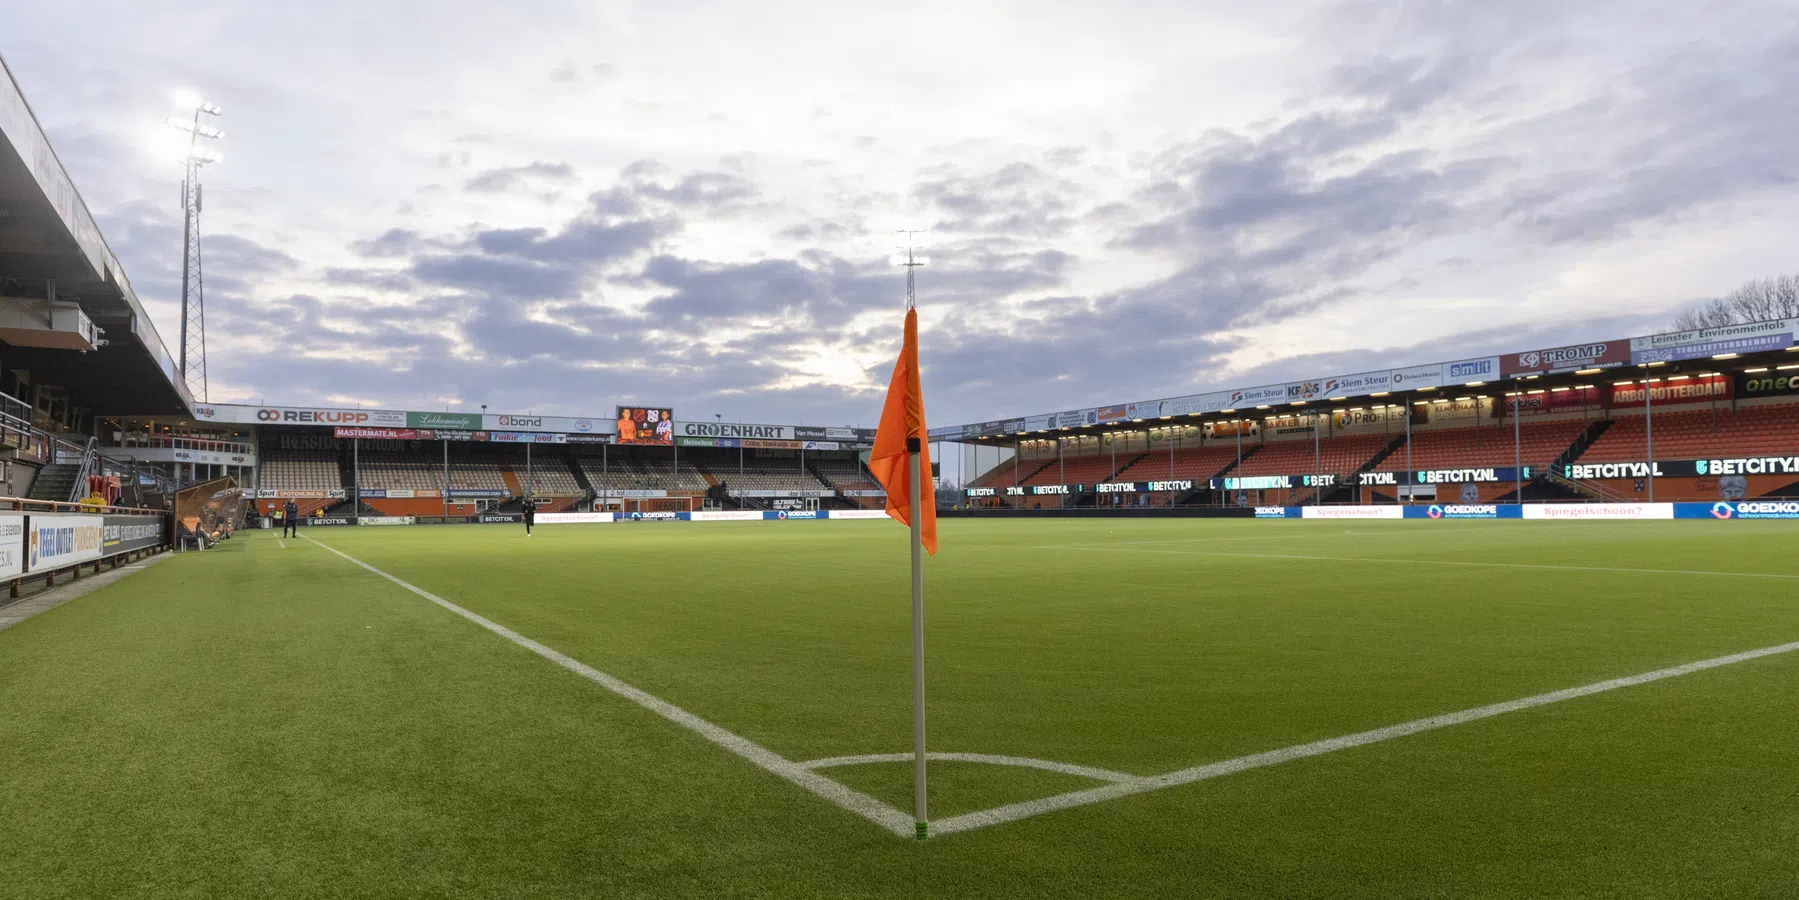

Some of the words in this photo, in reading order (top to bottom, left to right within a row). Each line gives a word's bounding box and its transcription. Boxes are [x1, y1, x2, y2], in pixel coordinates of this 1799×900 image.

[1652, 333, 1693, 344] Leinster
[1699, 320, 1786, 338] Environmentals
[1542, 344, 1606, 363] TROMP
[1452, 361, 1491, 376] smit
[1341, 380, 1363, 388] Siem
[1365, 376, 1388, 385] Steur
[1244, 391, 1263, 399] Siem
[1264, 389, 1283, 397] Steur
[1613, 388, 1645, 404] ARBO
[1649, 382, 1726, 400] ROTTERDAM
[1173, 405, 1190, 414] HOTEL
[1192, 401, 1226, 413] VOLENDAM
[284, 411, 369, 423] REKUPP
[1264, 418, 1299, 429] BAKKER
[336, 428, 398, 438] MASTERMATE.NL
[685, 423, 784, 438] GROENHART
[1426, 468, 1498, 483] BETCITY.NL
[1572, 462, 1663, 478] BETCITY.NL
[1099, 482, 1136, 492] BETCITY.NL
[1231, 476, 1293, 490] BETCITY.NL
[1317, 508, 1383, 516] Spiegelschoon?
[1444, 505, 1497, 514] GOEDKOPE
[1544, 507, 1642, 516] Spiegelschoon?
[39, 528, 55, 558] TEGEL
[56, 527, 74, 555] OUTLET
